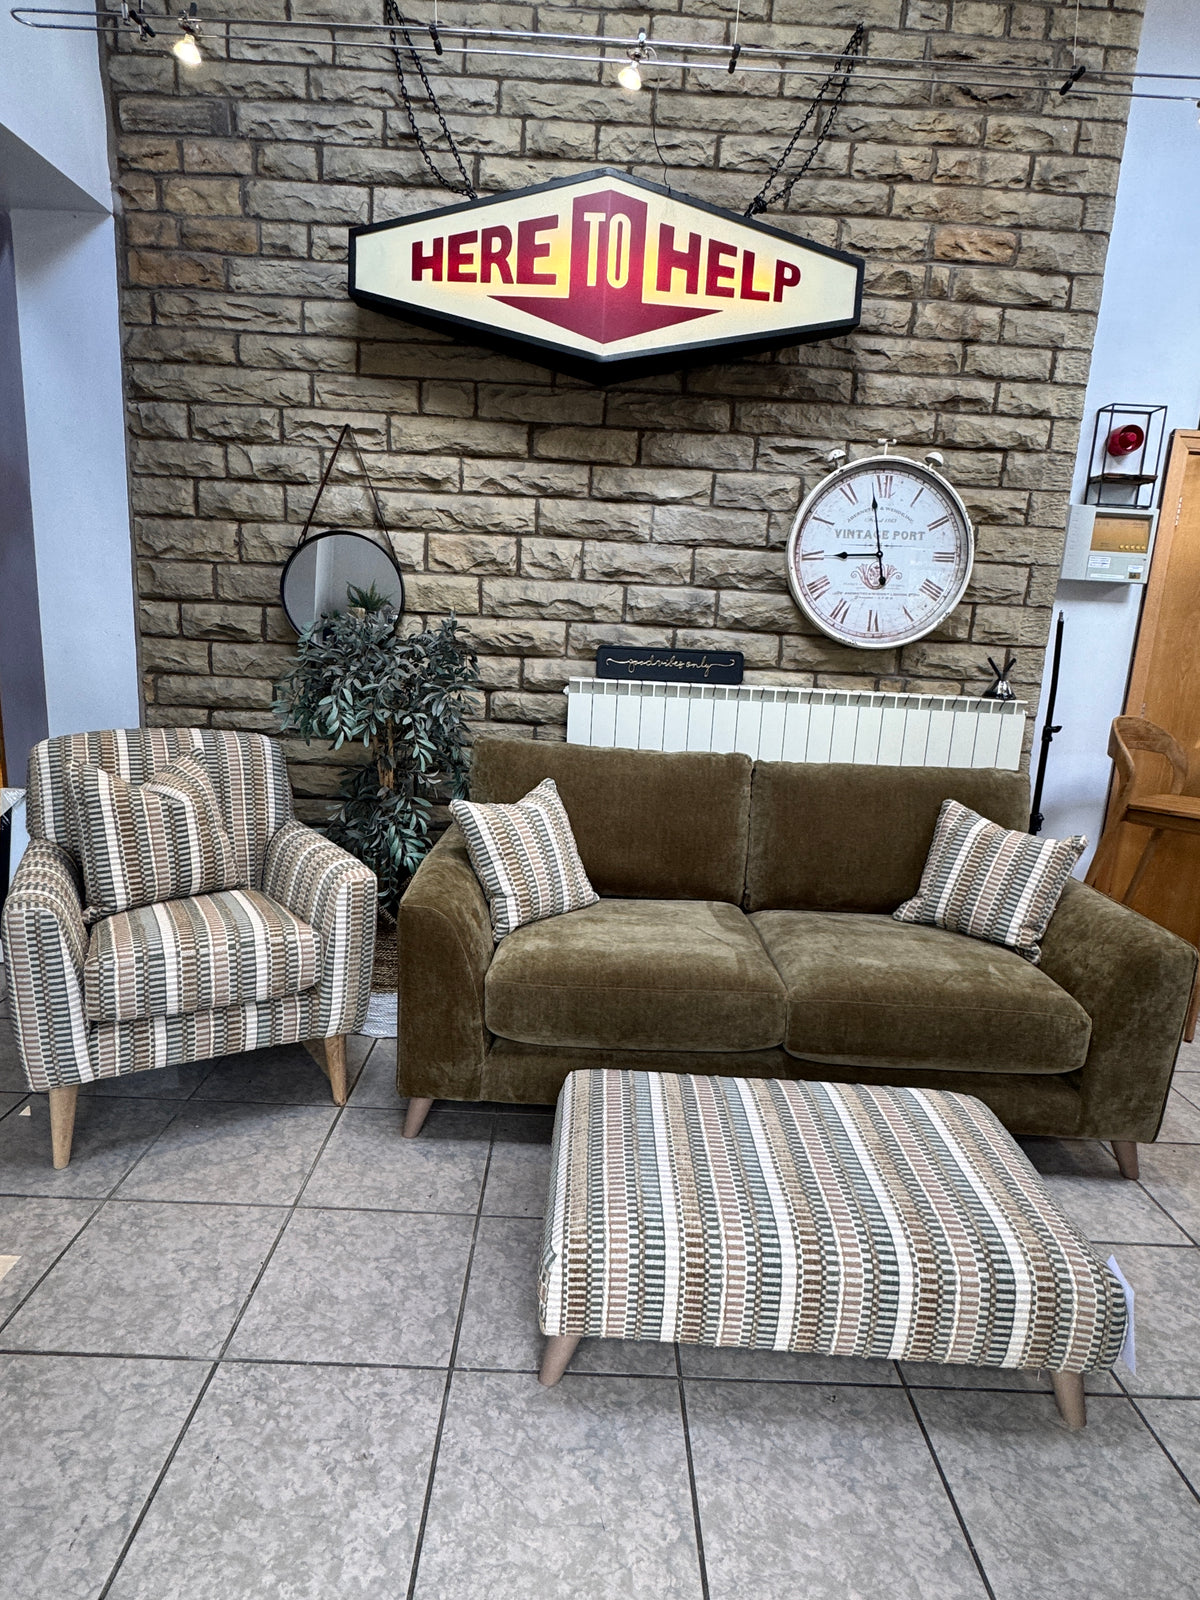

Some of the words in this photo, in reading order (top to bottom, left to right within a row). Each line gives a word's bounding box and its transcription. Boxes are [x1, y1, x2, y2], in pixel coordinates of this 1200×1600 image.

[411, 214, 559, 285] HERE
[583, 212, 631, 289] TO
[656, 222, 801, 303] HELP
[892, 531, 925, 541] PORT
[685, 655, 714, 678] only
